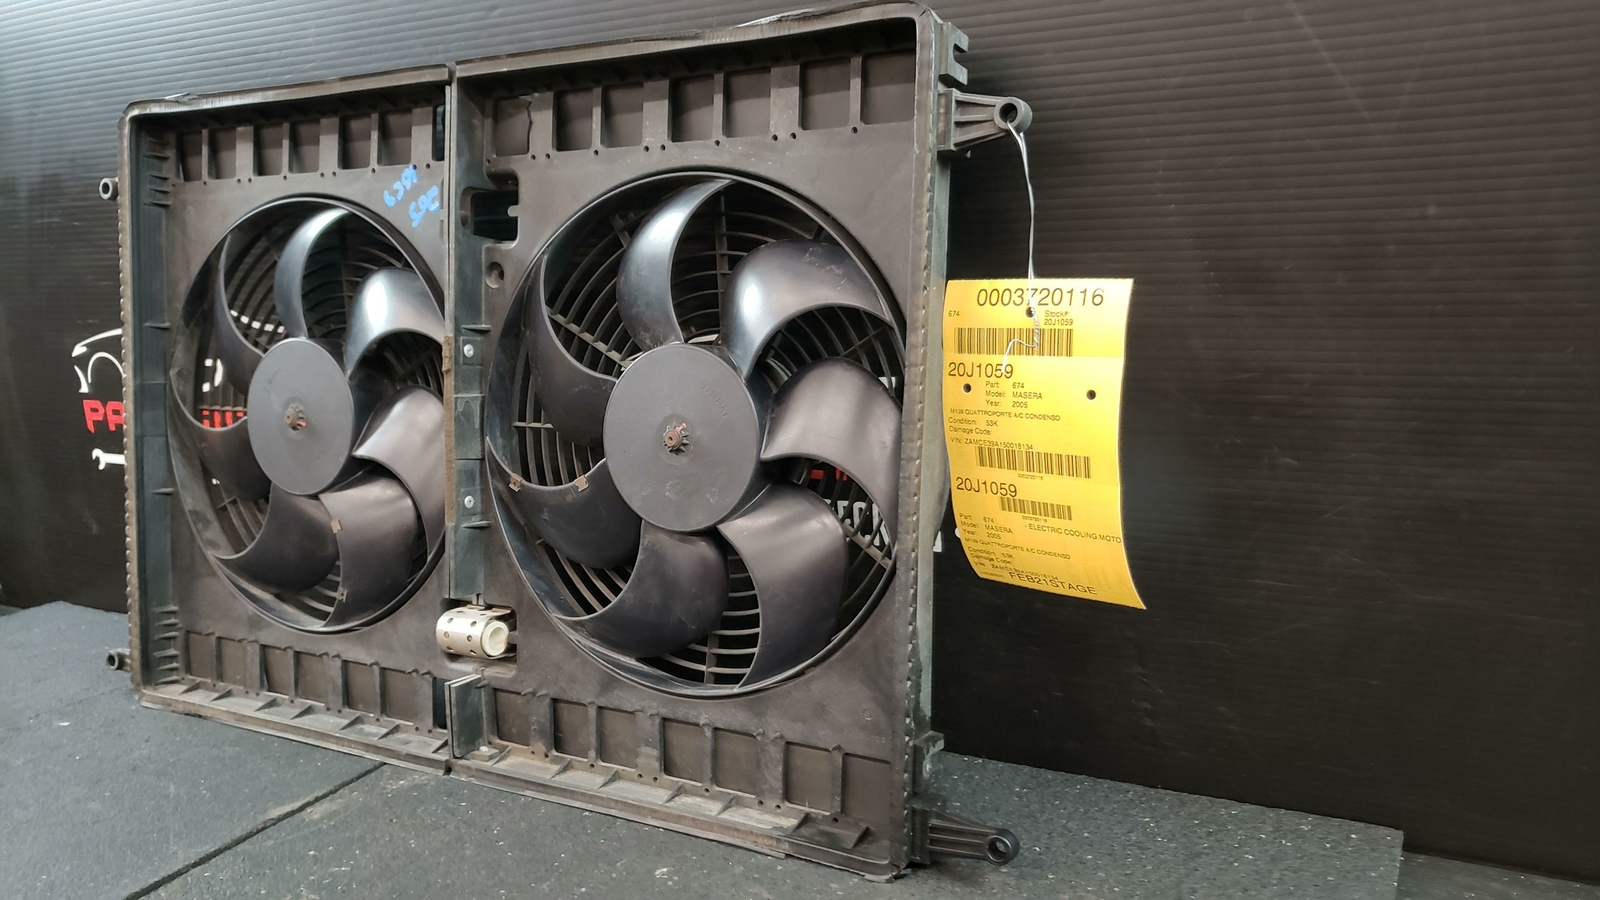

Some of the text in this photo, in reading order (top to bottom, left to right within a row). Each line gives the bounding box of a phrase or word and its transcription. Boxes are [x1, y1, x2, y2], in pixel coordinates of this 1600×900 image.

[976, 287, 1105, 307] 0003720116
[1044, 318, 1074, 326] 20J1059
[948, 362, 1014, 379] 20J1059
[1012, 391, 1043, 400] MASERA
[1012, 401, 1028, 409] 2005
[964, 409, 1012, 418] QUATTROPORTE
[1025, 413, 1061, 422] CONDENSO
[949, 425, 974, 435] Damage
[956, 476, 1017, 498] 20J1059
[984, 524, 1014, 535] MASERA
[986, 531, 1002, 540] 2005
[1028, 523, 1063, 536] ELECTRIC
[1063, 528, 1098, 541] COOLING
[1099, 533, 1122, 545] MOTO
[1008, 571, 1099, 595] FEB21STAGE
